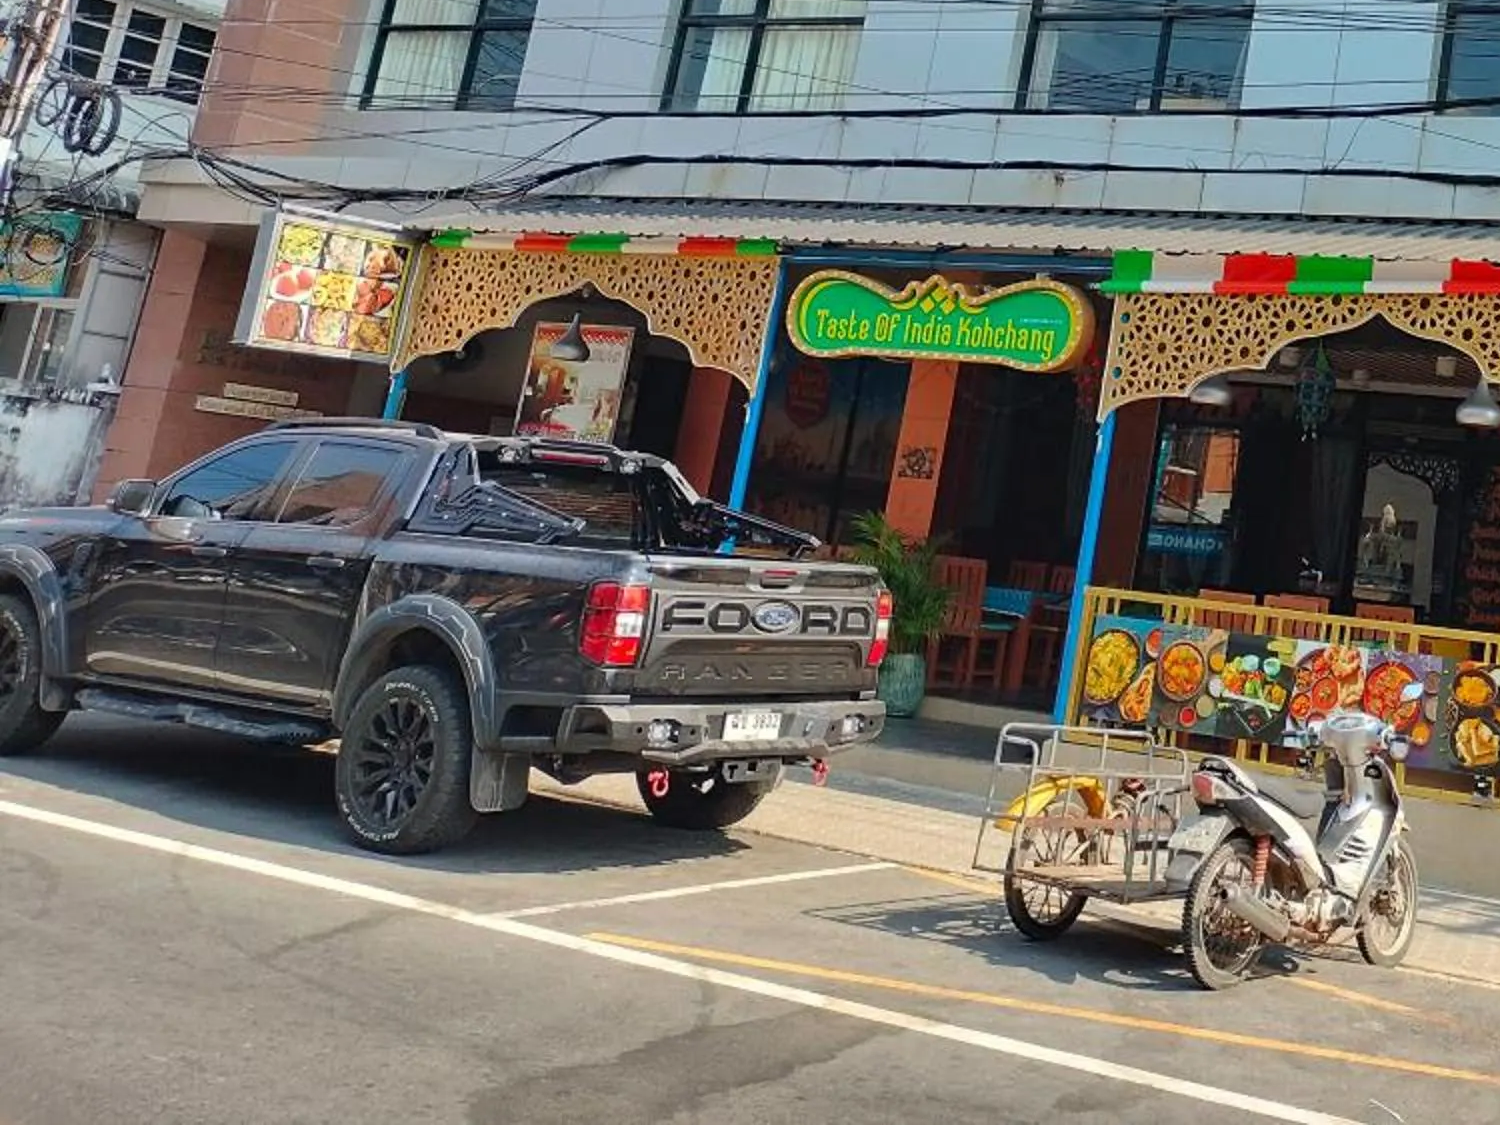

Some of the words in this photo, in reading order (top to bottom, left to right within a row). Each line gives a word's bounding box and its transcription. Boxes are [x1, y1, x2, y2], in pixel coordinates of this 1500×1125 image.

[816, 308, 870, 340] Taste
[903, 314, 952, 346] India
[956, 316, 1056, 360] Kohchang
